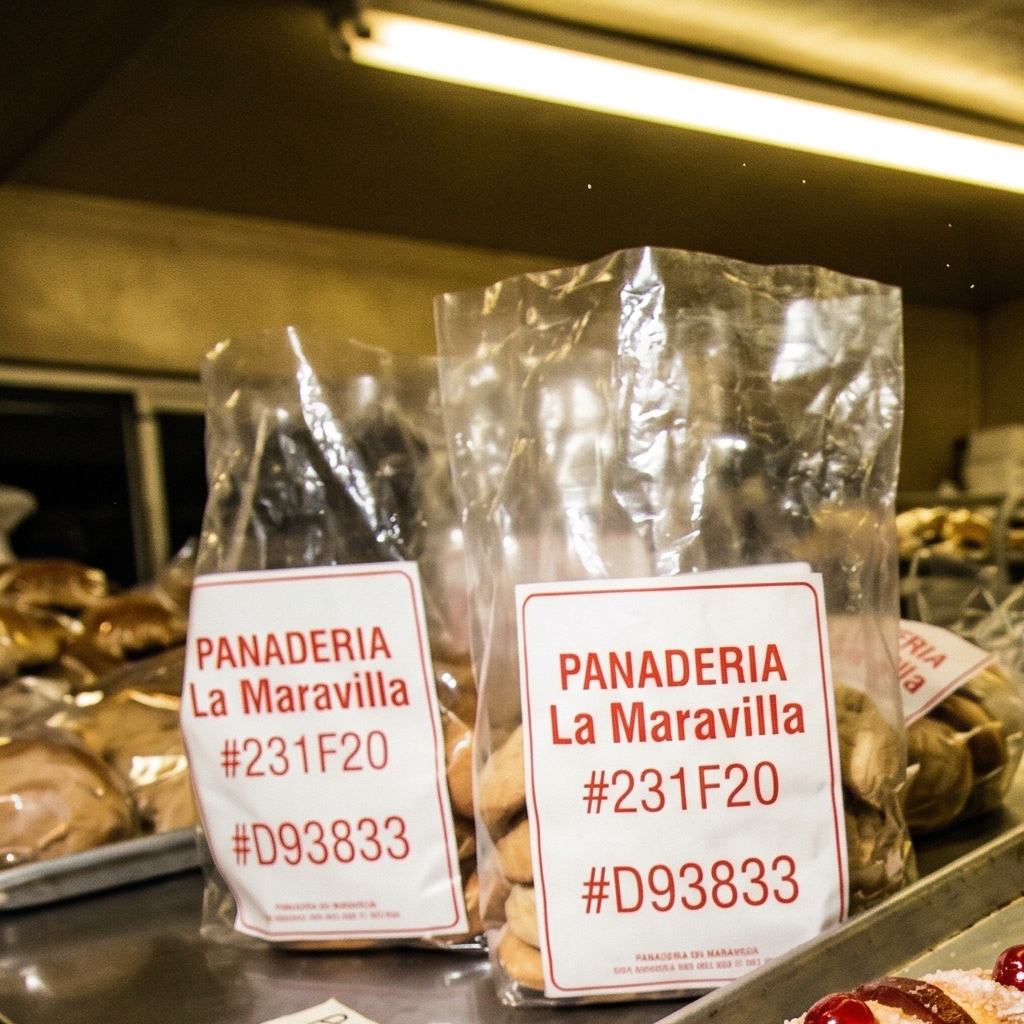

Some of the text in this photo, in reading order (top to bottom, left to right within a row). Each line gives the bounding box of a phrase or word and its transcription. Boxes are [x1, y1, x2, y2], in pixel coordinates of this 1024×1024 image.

[195, 626, 393, 670] PANADERIA
[558, 643, 788, 691] PANADERIA
[189, 671, 411, 718] La Maravilla
[549, 694, 805, 745] La Maravilla
[220, 730, 389, 778] #231F20
[582, 760, 780, 814] #231F20
[231, 815, 411, 868] #D93833
[581, 854, 800, 914] #D93833
